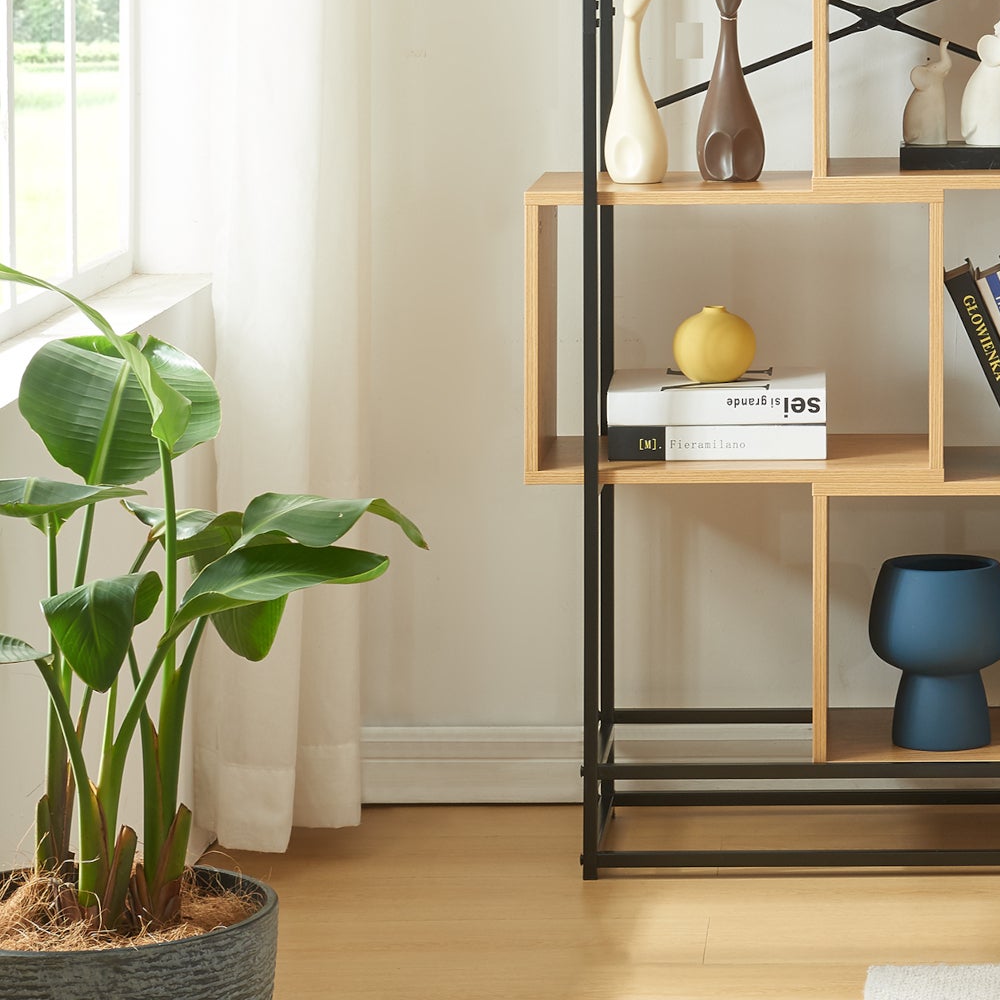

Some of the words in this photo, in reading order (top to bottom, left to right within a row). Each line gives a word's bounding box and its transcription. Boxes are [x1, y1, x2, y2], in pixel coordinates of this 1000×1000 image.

[726, 395, 767, 408] grande
[770, 398, 781, 408] si
[783, 396, 821, 418] sei
[669, 439, 746, 449] Fieramilano
